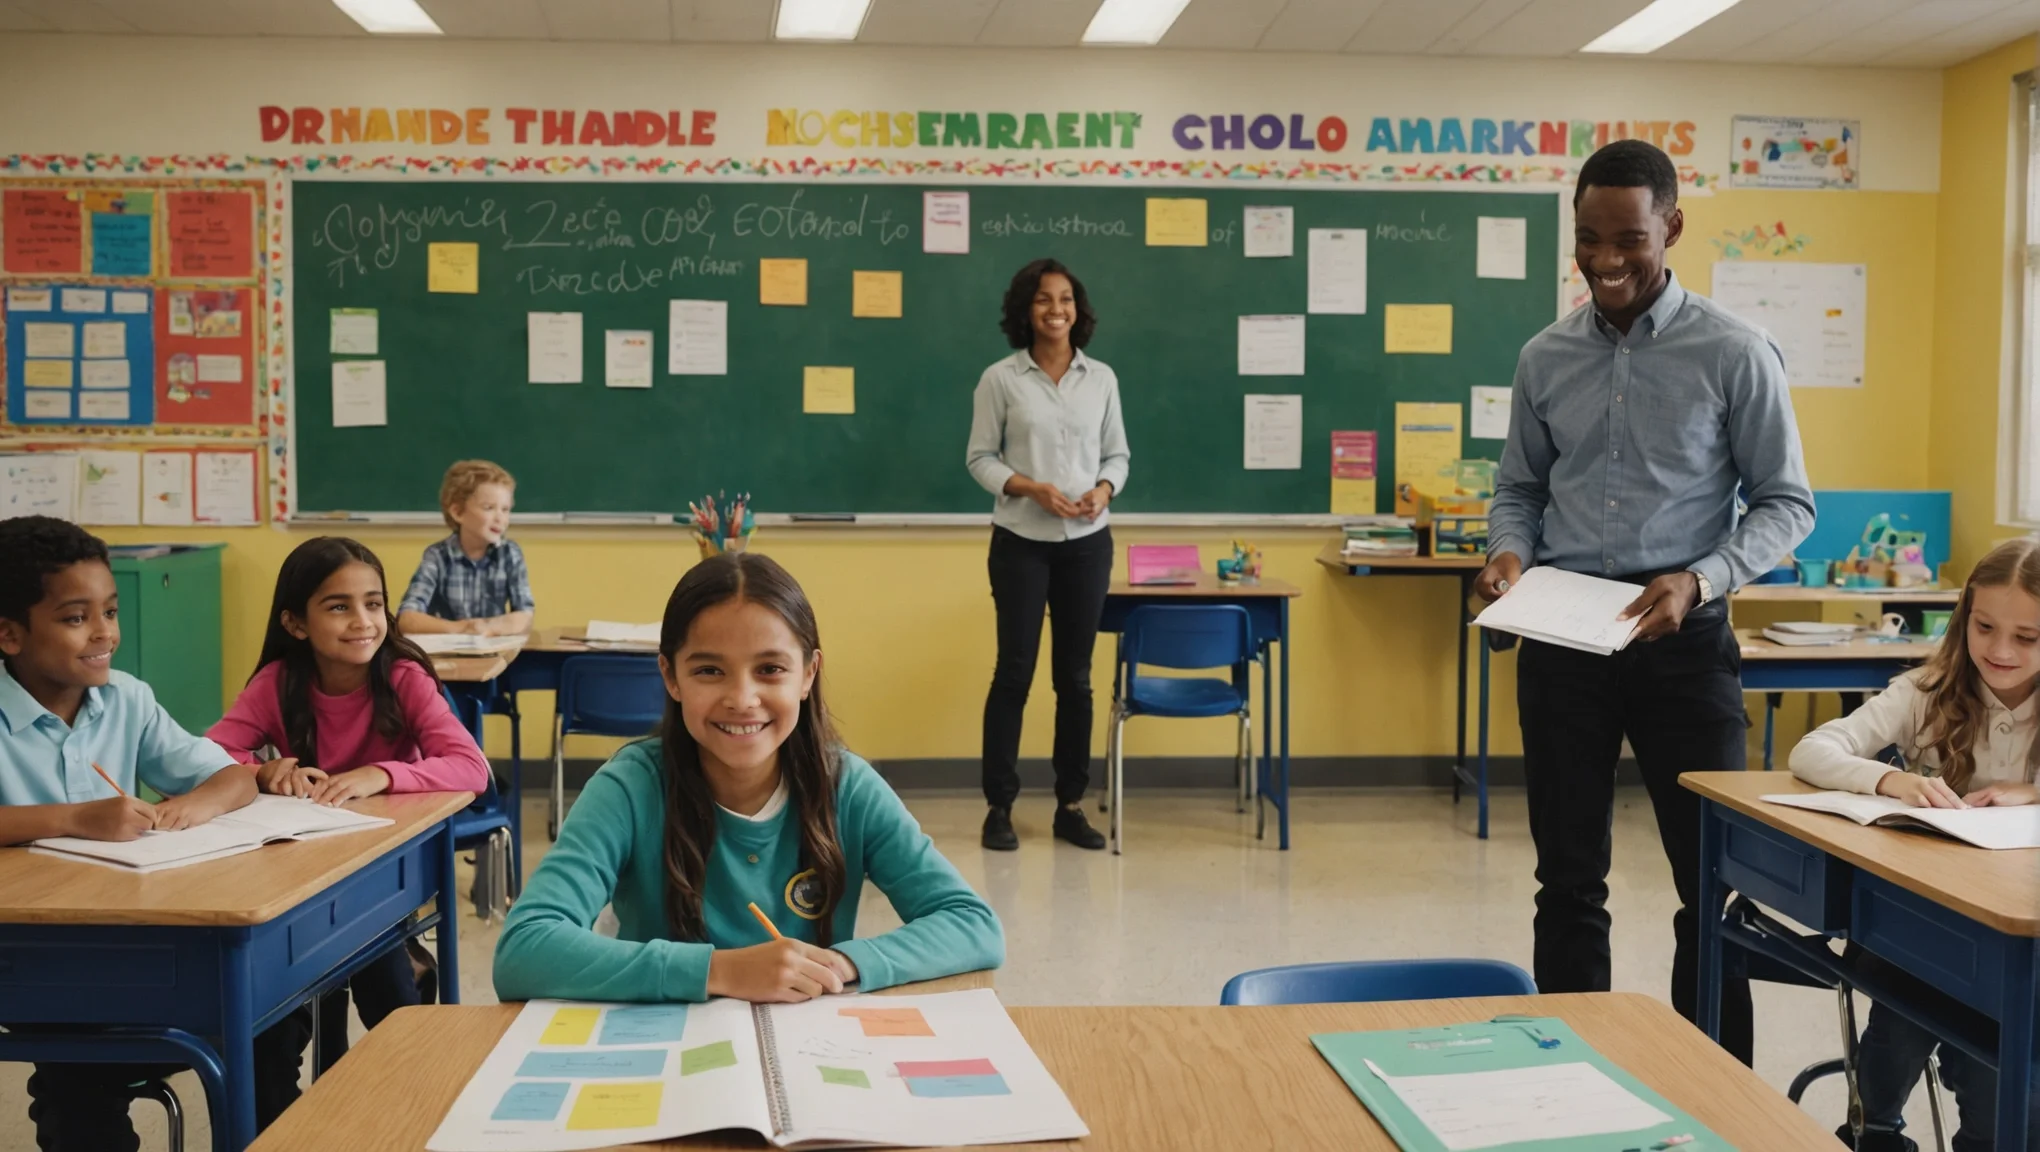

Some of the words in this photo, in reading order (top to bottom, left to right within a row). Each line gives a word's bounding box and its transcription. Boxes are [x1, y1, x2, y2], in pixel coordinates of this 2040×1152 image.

[505, 107, 716, 147] THANDLE
[1172, 114, 1347, 153] CHOLO
[1211, 219, 1237, 250] of
